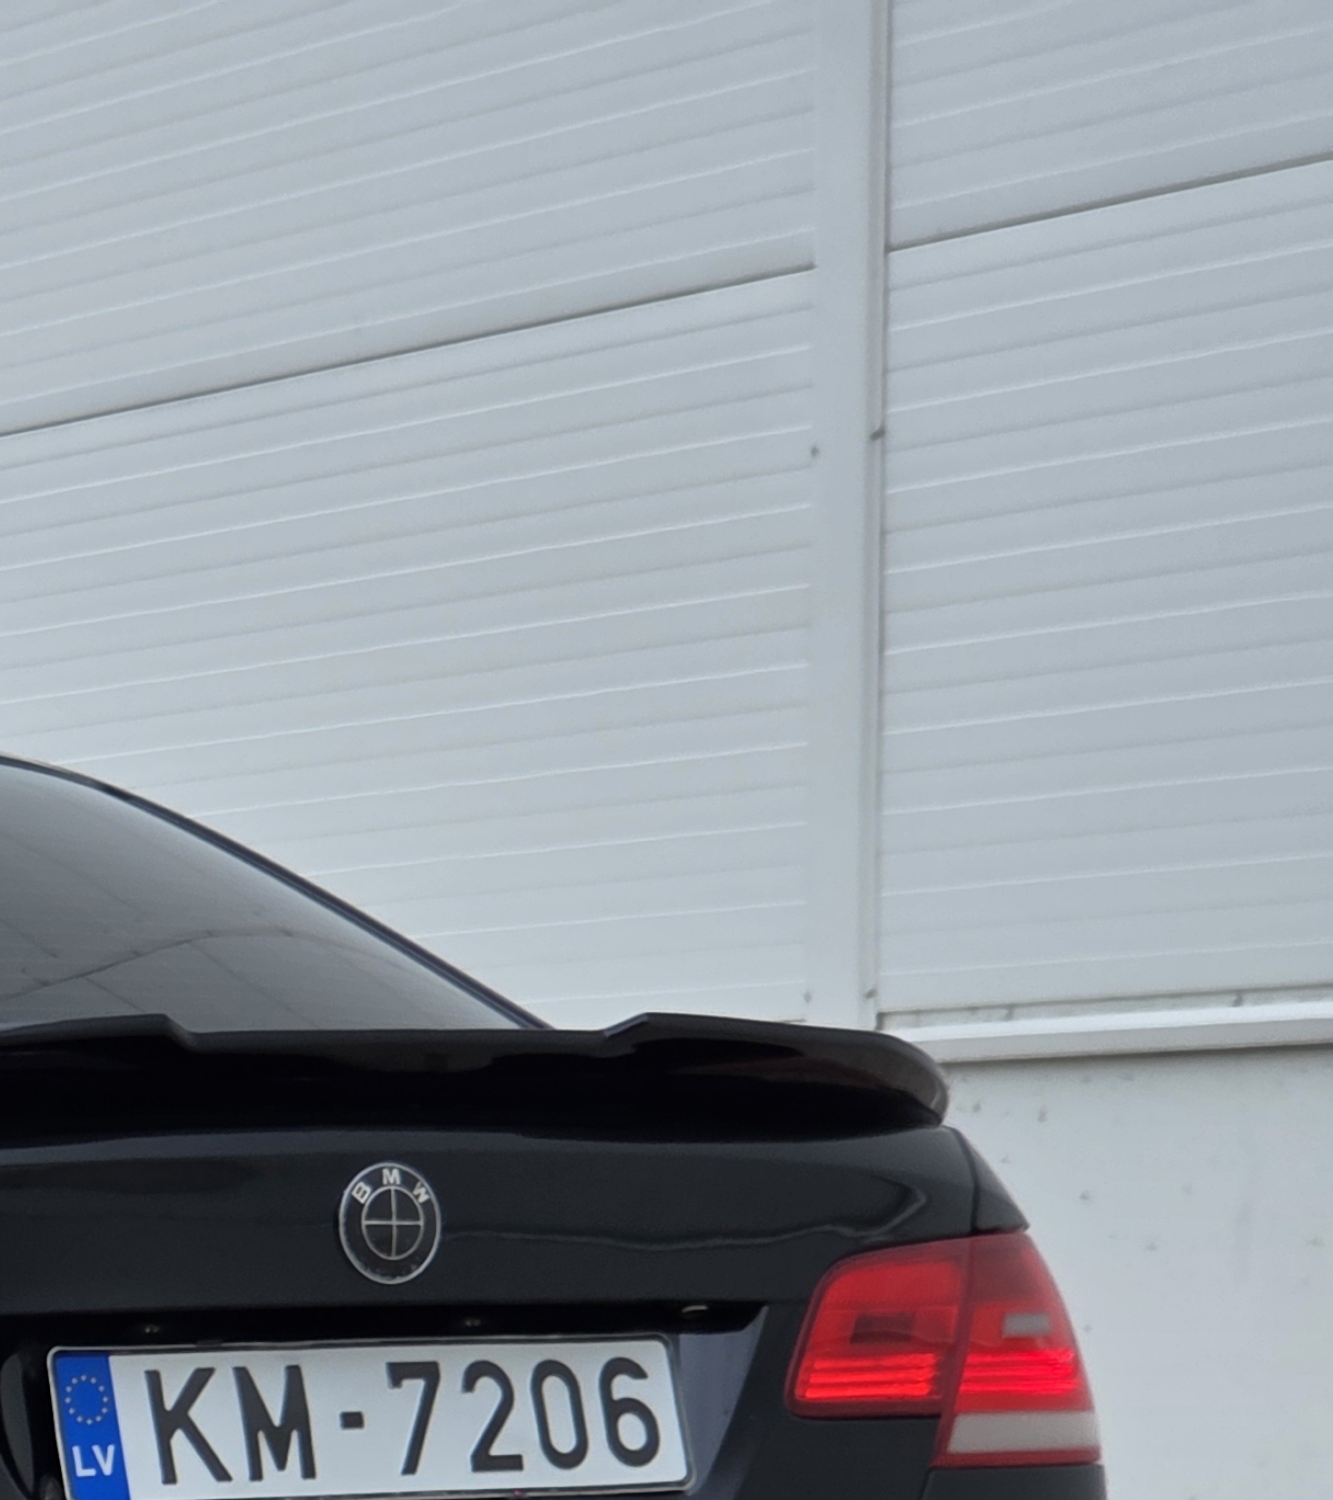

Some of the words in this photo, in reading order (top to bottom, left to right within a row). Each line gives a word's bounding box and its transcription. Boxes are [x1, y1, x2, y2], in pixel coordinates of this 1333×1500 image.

[351, 1168, 431, 1205] BMW
[143, 1356, 661, 1485] KM-7206
[72, 1444, 116, 1478] LV
